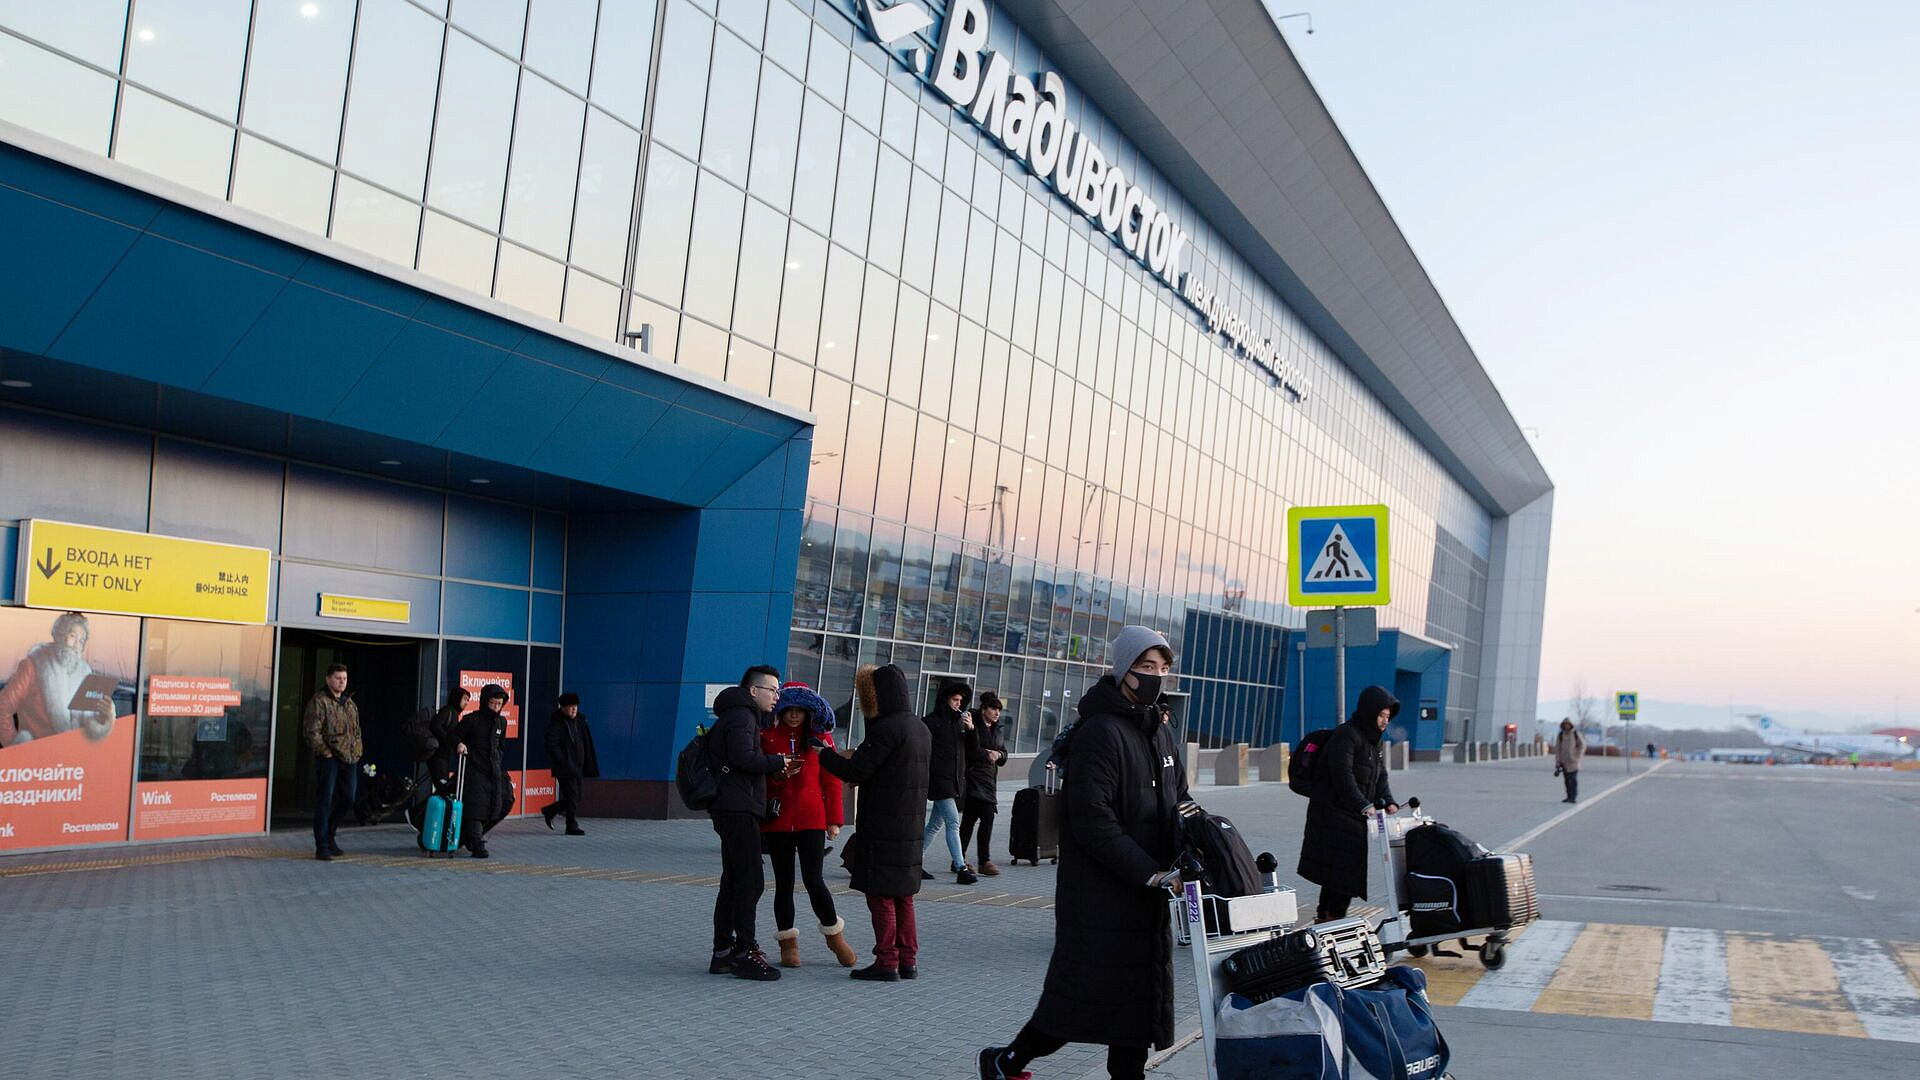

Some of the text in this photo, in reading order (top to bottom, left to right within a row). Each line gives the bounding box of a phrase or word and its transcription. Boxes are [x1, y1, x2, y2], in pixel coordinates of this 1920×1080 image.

[931, 0, 1313, 402] Владивосток международный аэропорт
[66, 547, 152, 570] ВХОДА НЕТ
[64, 571, 142, 592] EXIT ONLY
[152, 678, 189, 689] Подписка
[190, 681, 195, 689] с
[151, 703, 224, 714] Бесплатно 30 дней
[141, 790, 172, 805] Wink
[210, 792, 257, 802] Ростелеком
[62, 821, 119, 833] Ростелеком
[1188, 901, 1199, 922] 222
